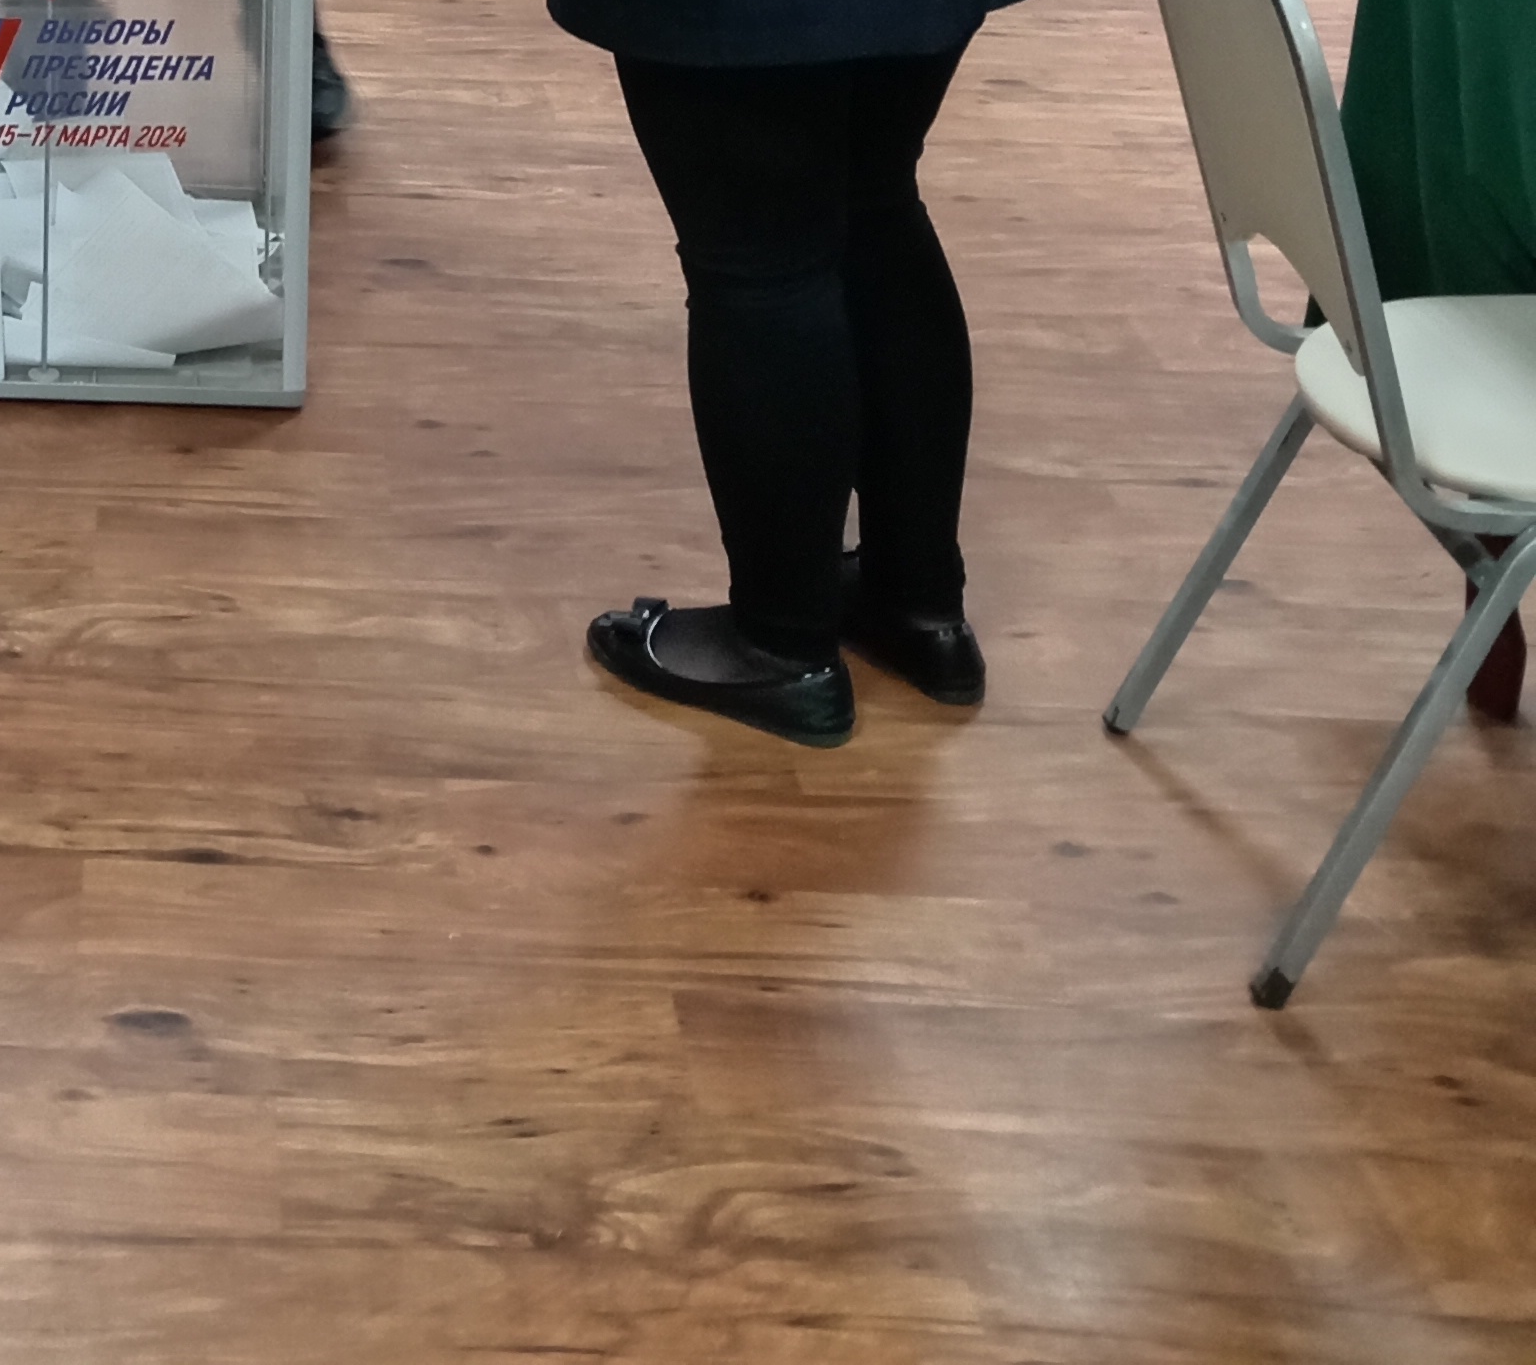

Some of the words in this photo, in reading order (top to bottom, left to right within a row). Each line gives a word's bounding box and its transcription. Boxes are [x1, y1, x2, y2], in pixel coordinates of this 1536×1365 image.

[36, 19, 175, 45] ВЫБОРЫ
[22, 55, 215, 85] ПРЕЗИДЕНТА
[4, 91, 131, 116] РОССИИ
[55, 124, 131, 147] МАРТА
[133, 125, 187, 148] 2024
